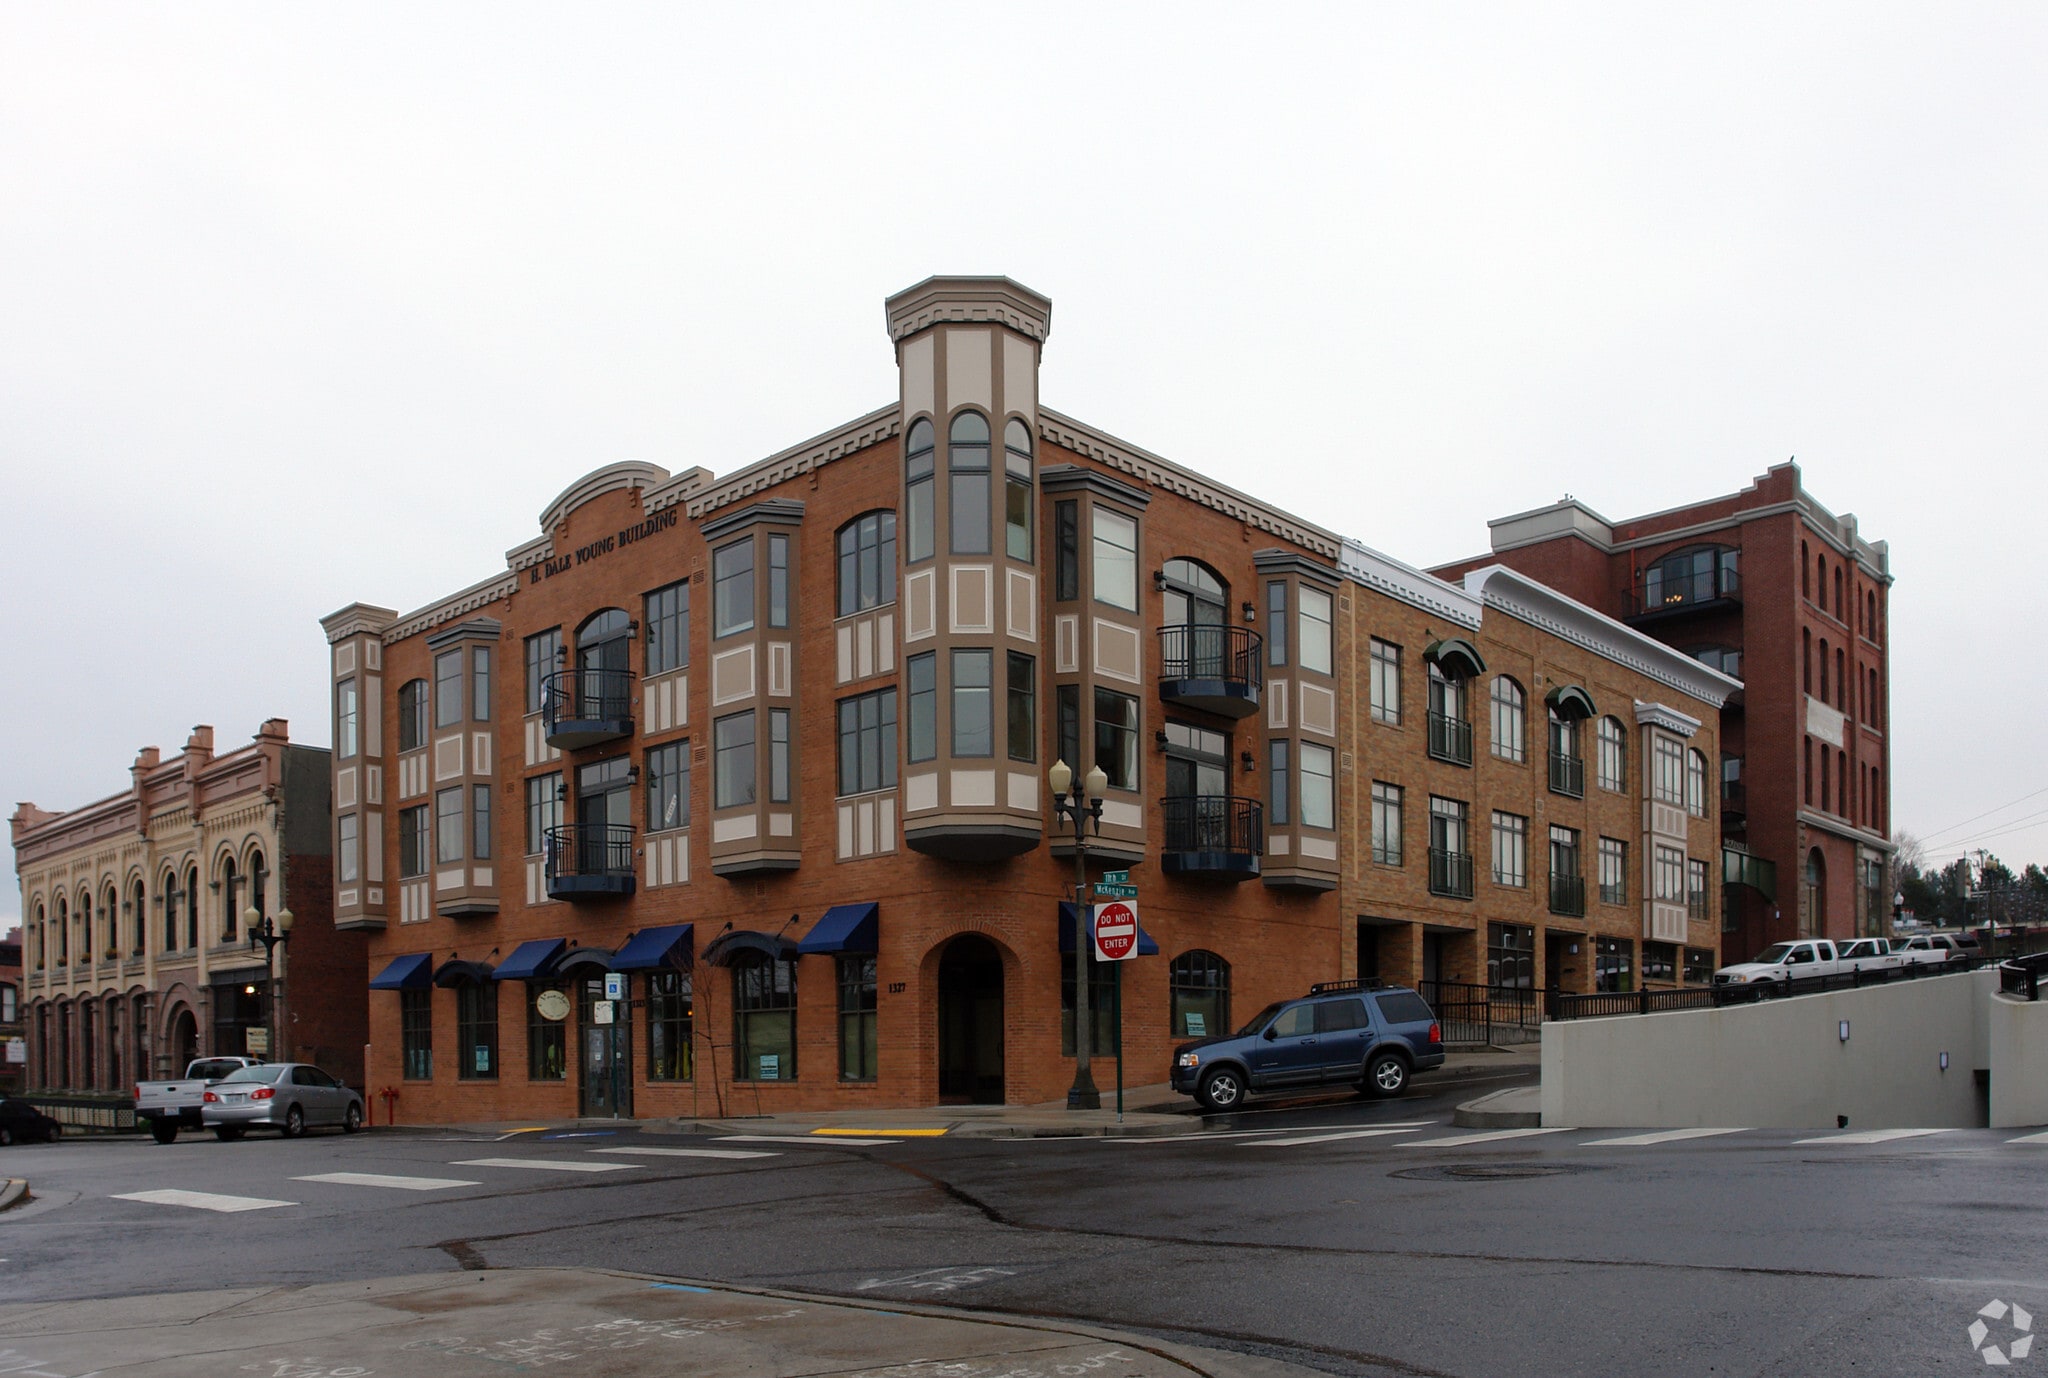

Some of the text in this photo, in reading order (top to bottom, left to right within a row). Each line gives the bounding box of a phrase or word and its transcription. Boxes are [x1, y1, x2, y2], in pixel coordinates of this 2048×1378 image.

[530, 509, 677, 584] H. DALE YOUNG BUILDING
[1097, 884, 1125, 896] McKenzie
[1101, 913, 1130, 924] DO NOT
[1104, 938, 1128, 949] ENTER
